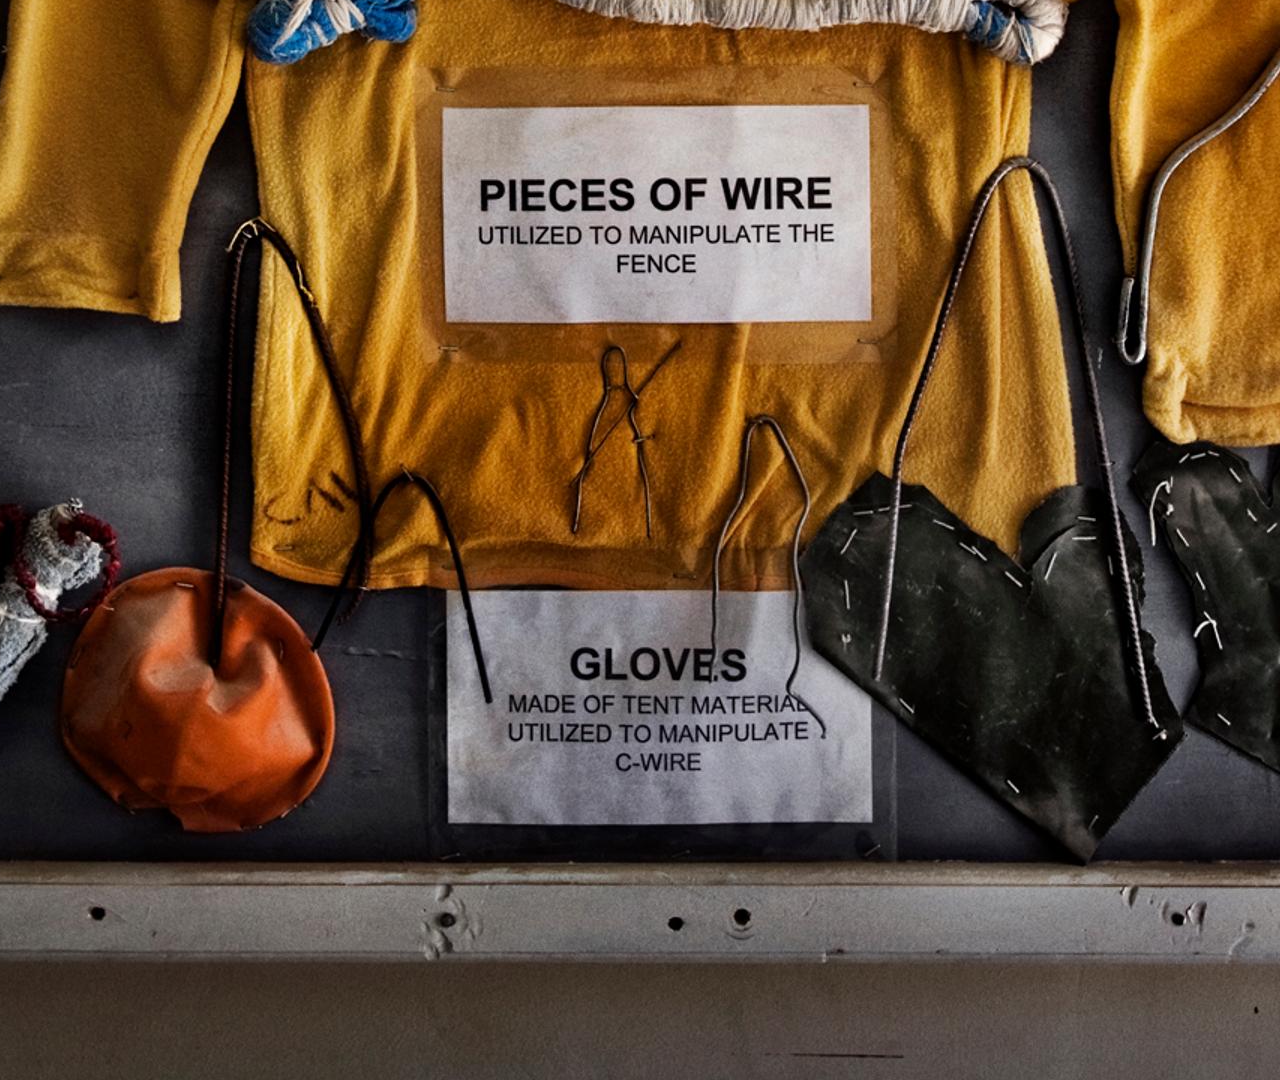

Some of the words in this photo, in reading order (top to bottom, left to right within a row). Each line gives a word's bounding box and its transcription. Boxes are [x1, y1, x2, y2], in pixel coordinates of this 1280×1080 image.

[480, 177, 635, 213] PIECES
[649, 177, 708, 212] OF
[720, 176, 833, 211] WIRE
[478, 225, 583, 245] UTILIZED
[588, 225, 622, 245] TO
[629, 224, 781, 245] MANIPULATE
[788, 223, 835, 243] THE
[616, 253, 697, 274] FENCE
[569, 647, 747, 682] GLOVES
[508, 693, 576, 714] MADE
[583, 694, 616, 714] OF
[621, 694, 685, 715] TENT
[691, 694, 808, 715] MATERIAL
[508, 722, 613, 744] UTILIZED
[618, 723, 652, 744] TO
[658, 721, 809, 744] MANIPULATE
[615, 752, 702, 773] C-WIRE
